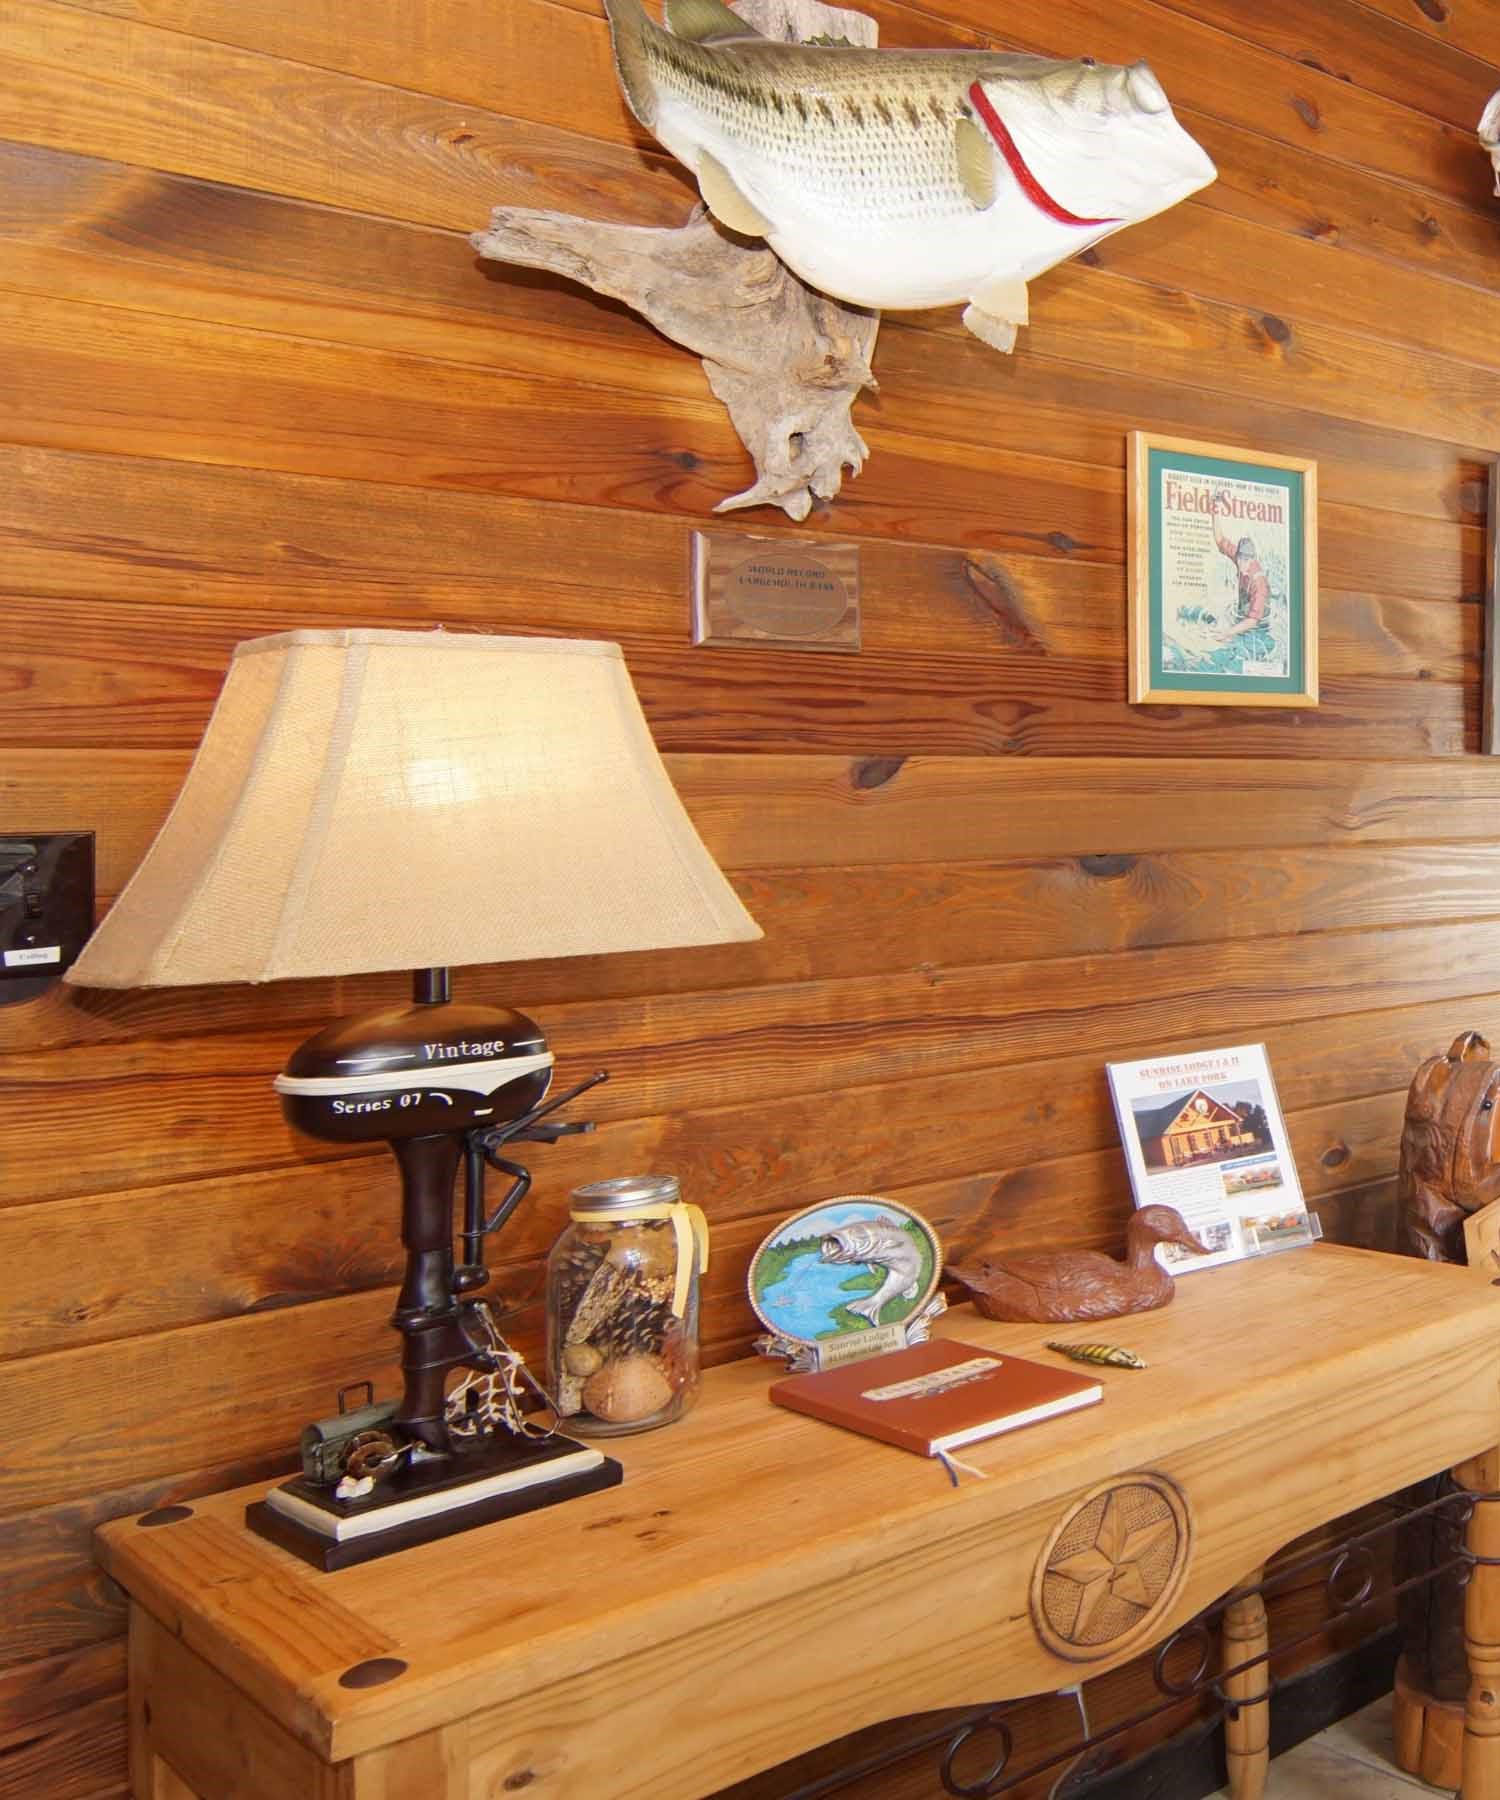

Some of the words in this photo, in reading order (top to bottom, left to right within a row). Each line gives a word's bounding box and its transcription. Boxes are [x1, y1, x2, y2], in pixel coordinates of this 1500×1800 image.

[1220, 488, 1284, 524] Stream
[423, 1040, 505, 1061] Vintage
[332, 1097, 392, 1114] Series
[400, 1092, 421, 1107] 07
